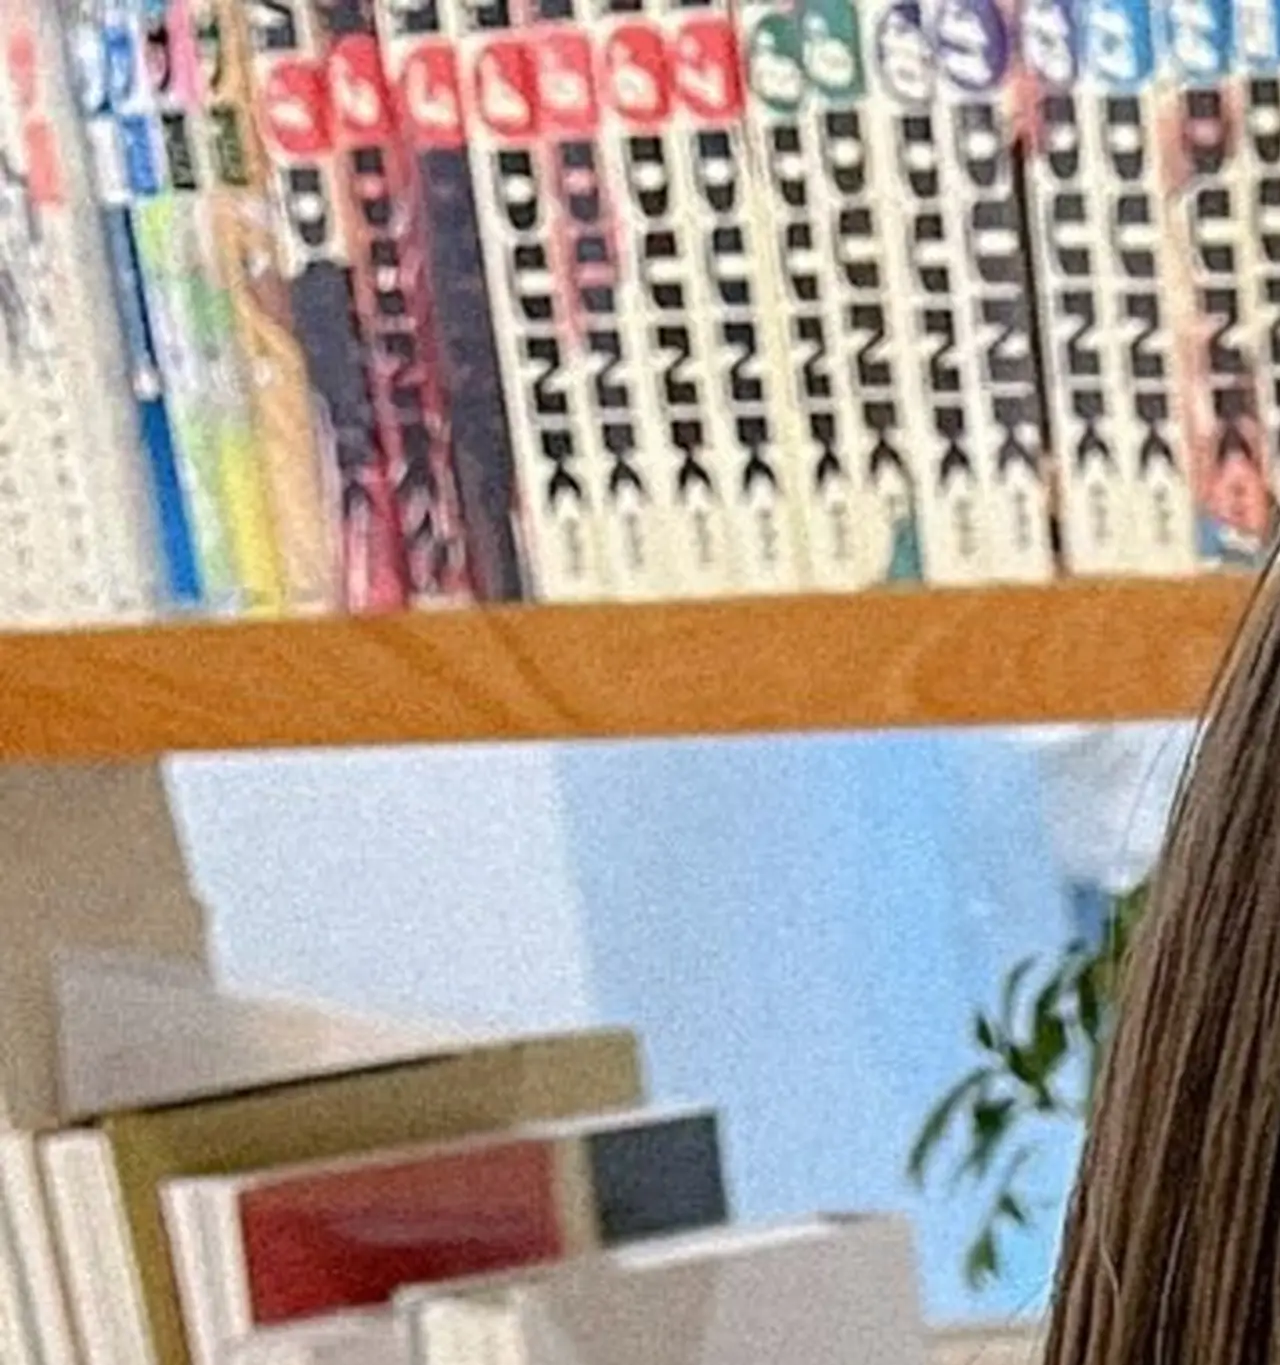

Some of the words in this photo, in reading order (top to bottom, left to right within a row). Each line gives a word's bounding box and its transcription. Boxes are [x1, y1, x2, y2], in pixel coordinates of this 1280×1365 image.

[497, 149, 582, 499] DUNK
[555, 140, 645, 496] DUNK
[627, 135, 712, 493] DUNK
[695, 128, 779, 492] DUNK
[771, 124, 842, 477] DUNK
[824, 110, 904, 469] DUNK
[901, 114, 974, 479] DUNK
[1041, 96, 1112, 467] DUNK
[1107, 96, 1177, 467] DUNK
[1185, 90, 1257, 463] DUNK
